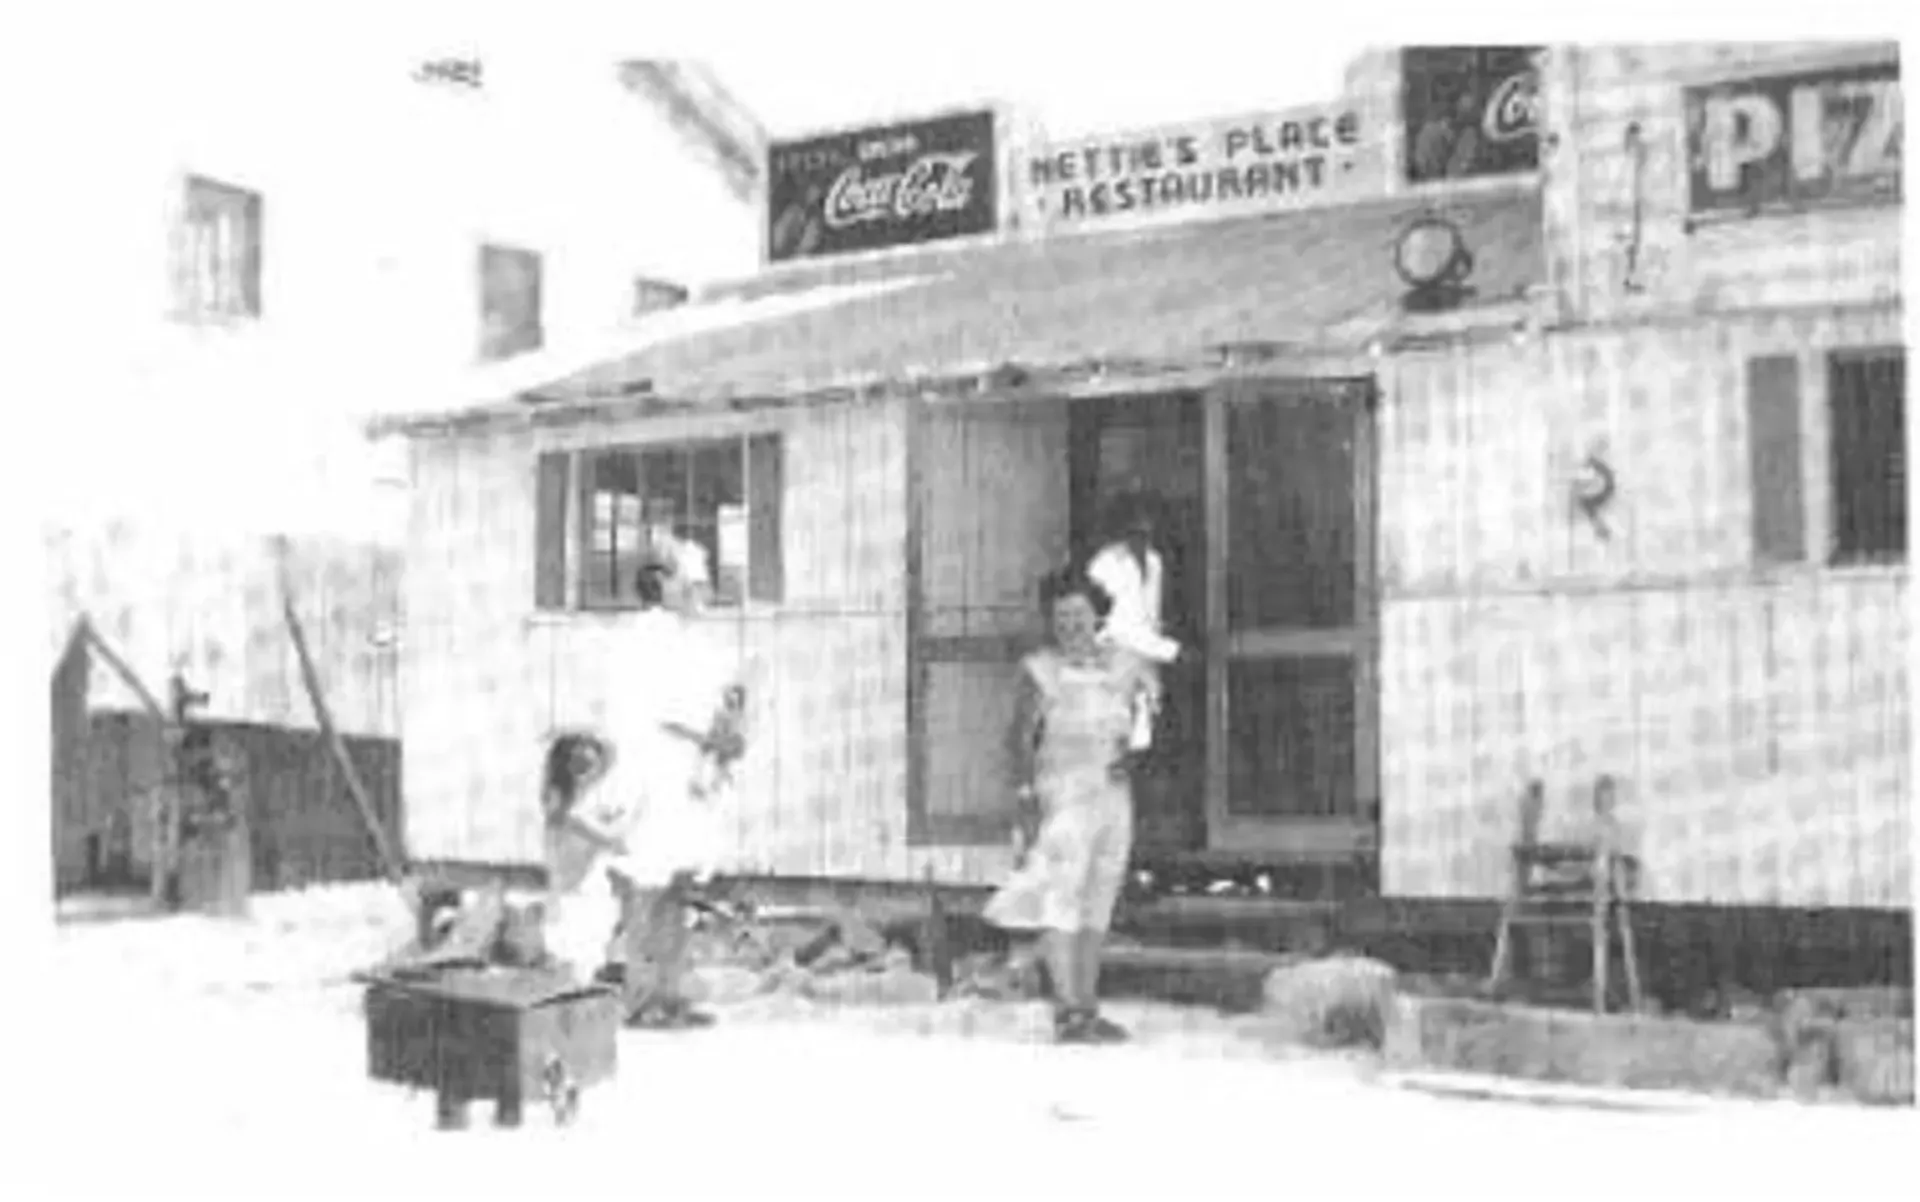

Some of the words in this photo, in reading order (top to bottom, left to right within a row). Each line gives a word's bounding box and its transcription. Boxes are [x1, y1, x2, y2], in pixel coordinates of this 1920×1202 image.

[1029, 135, 1198, 186] NETTIE'S
[1225, 112, 1359, 158] PLACE
[1062, 156, 1326, 217] RESTAURANT
